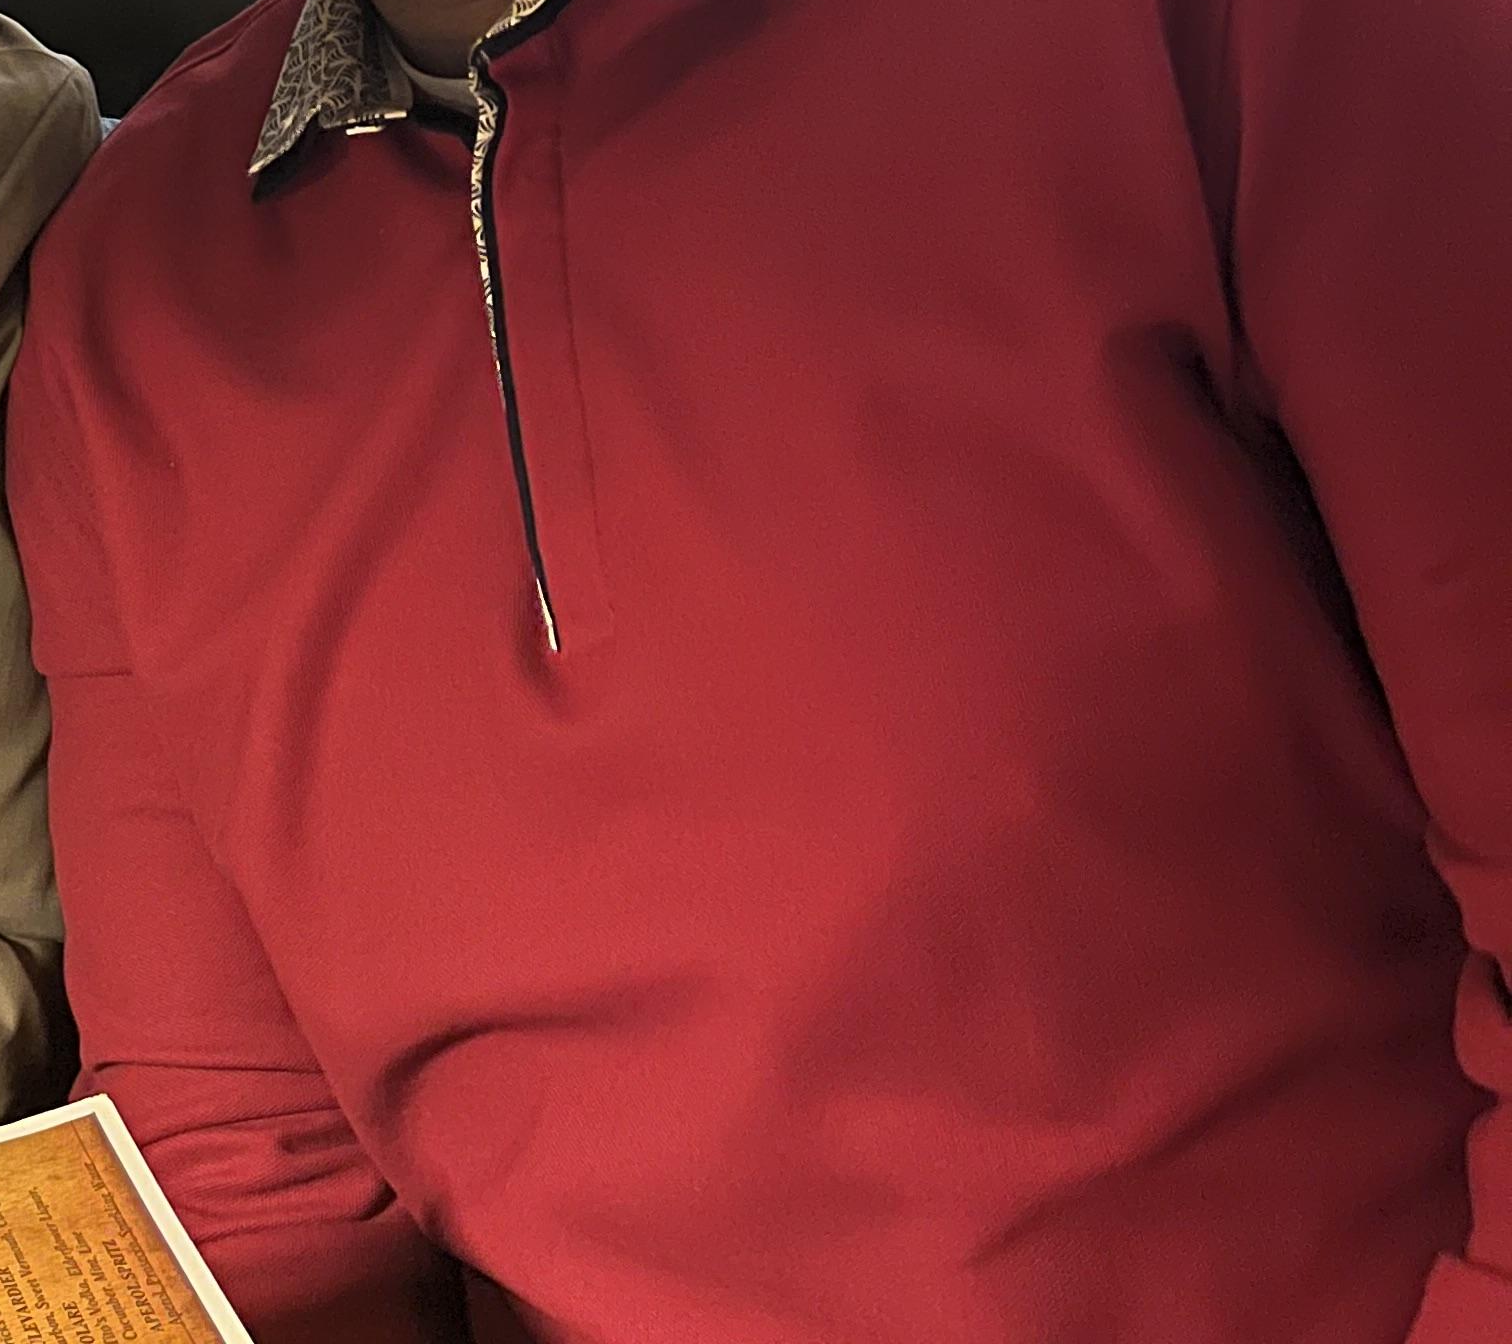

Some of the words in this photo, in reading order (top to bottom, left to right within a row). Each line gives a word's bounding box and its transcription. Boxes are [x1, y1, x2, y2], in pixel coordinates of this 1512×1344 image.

[46, 1222, 83, 1277] Elderflower
[71, 1230, 92, 1255] Lime
[101, 1238, 136, 1281] SPRITZ
[26, 1278, 50, 1310] Sweet
[126, 1280, 165, 1332] APEROL
